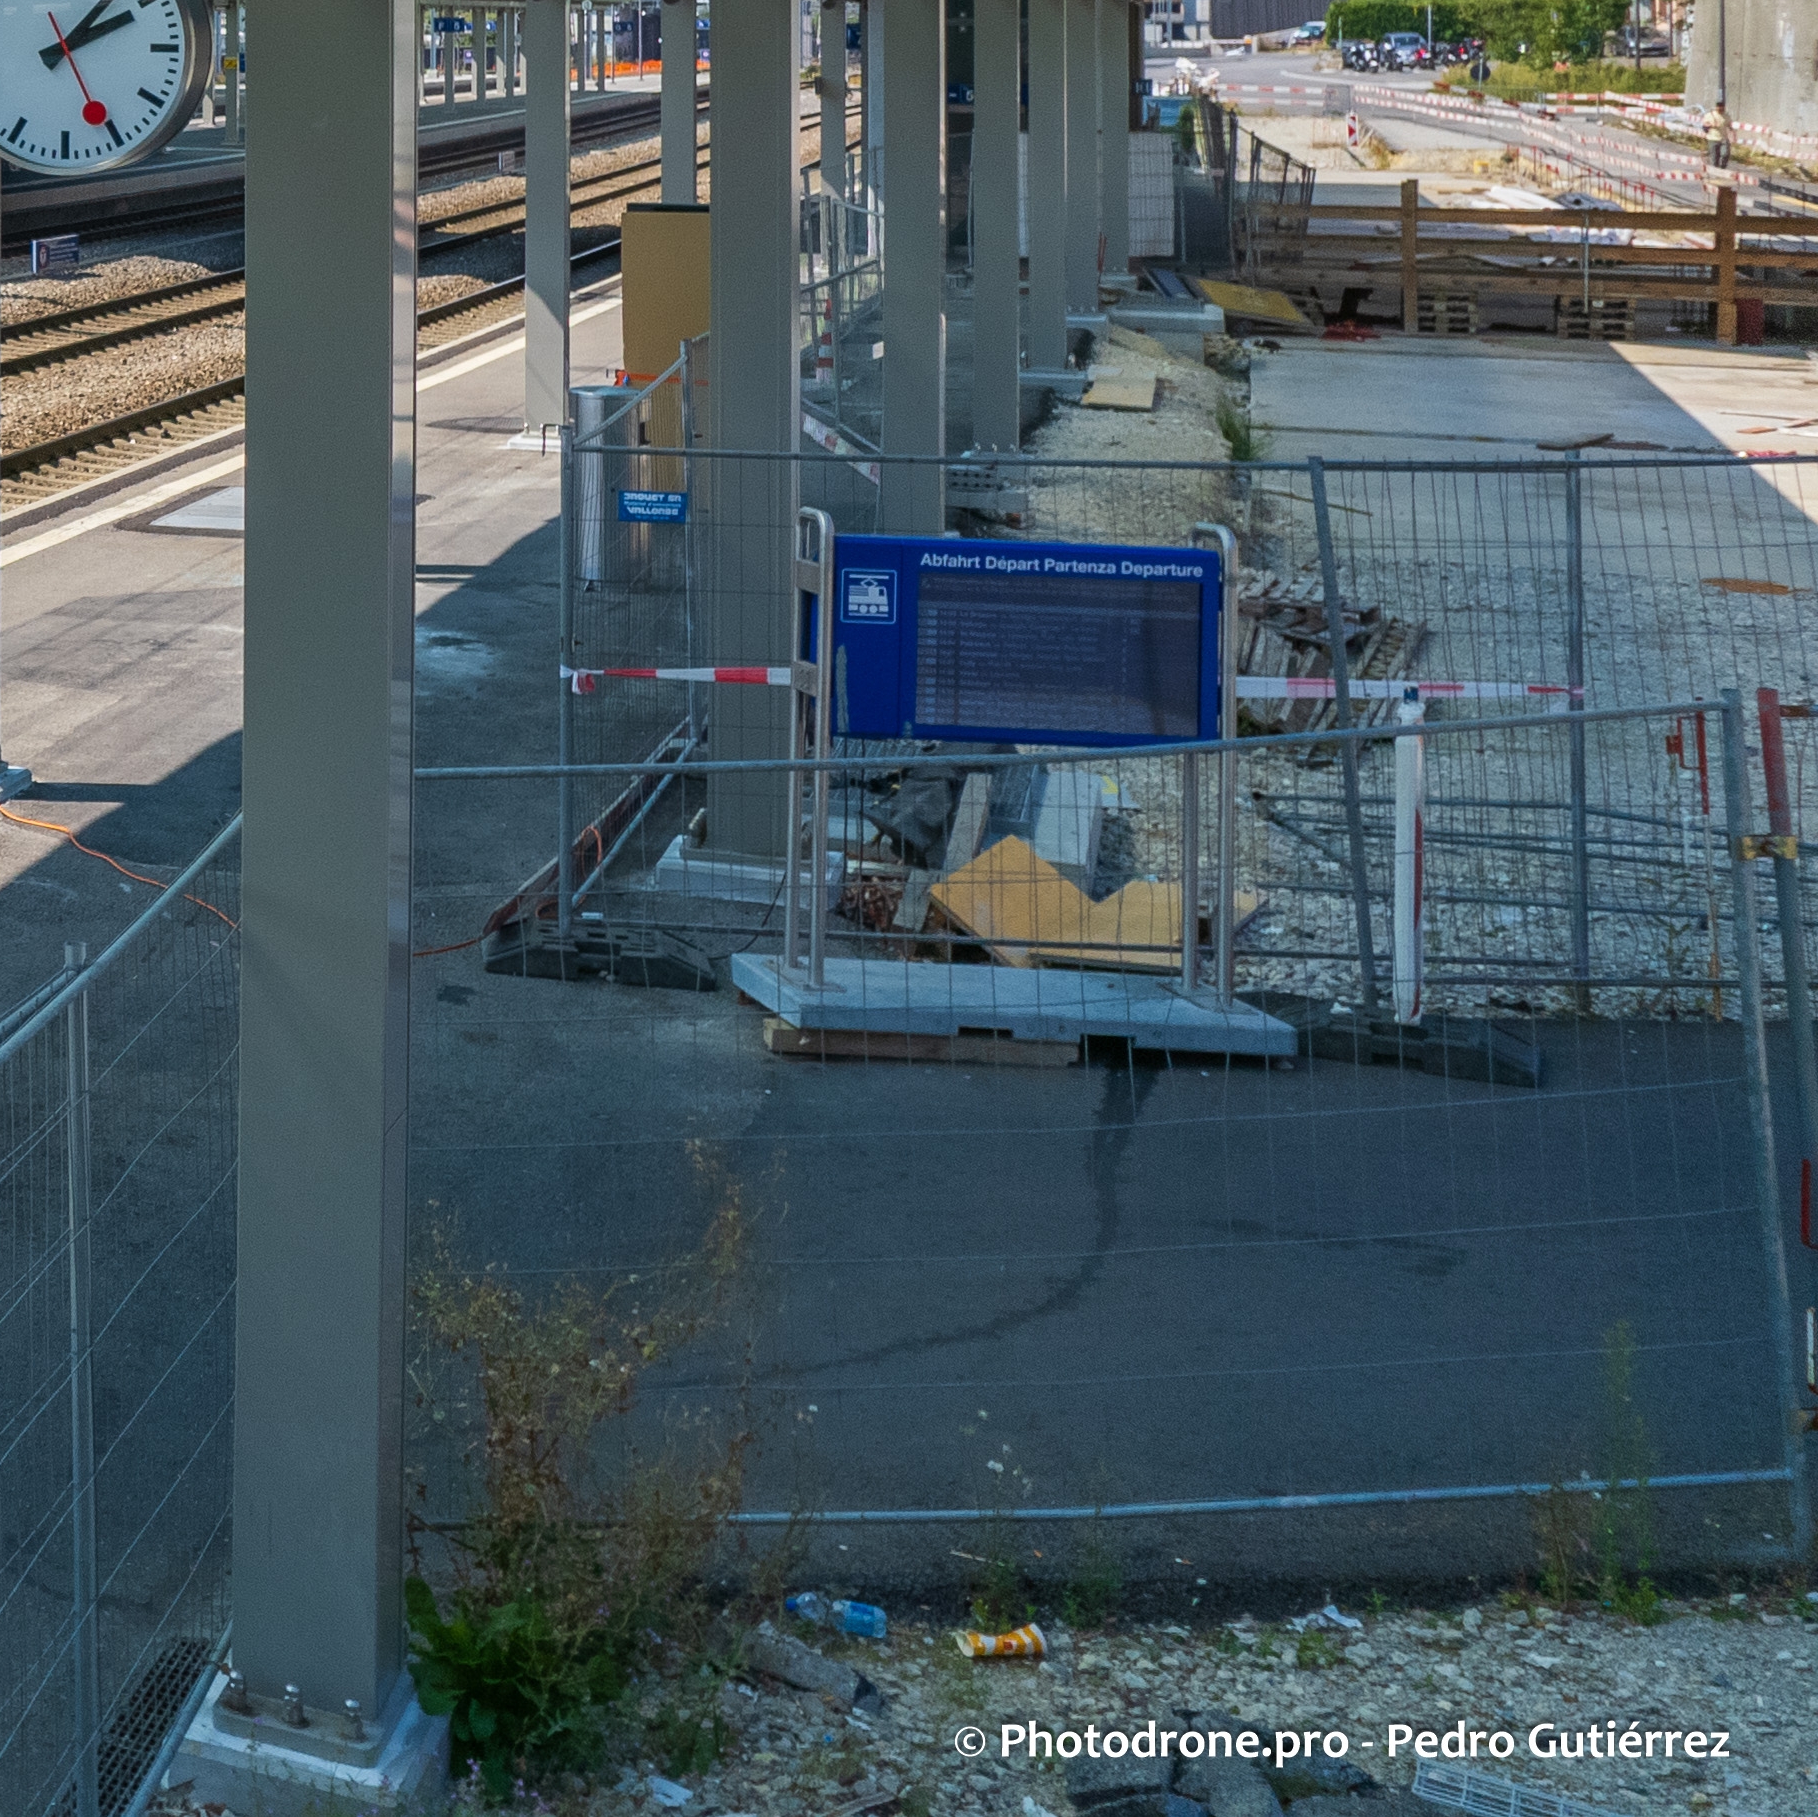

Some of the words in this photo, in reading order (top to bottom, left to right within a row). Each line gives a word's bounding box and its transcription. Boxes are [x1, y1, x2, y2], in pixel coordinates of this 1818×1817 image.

[920, 553, 980, 569] Abfahrt
[985, 555, 1039, 573] Départ
[1044, 558, 1116, 574] Partenza
[1121, 561, 1203, 578] Departure
